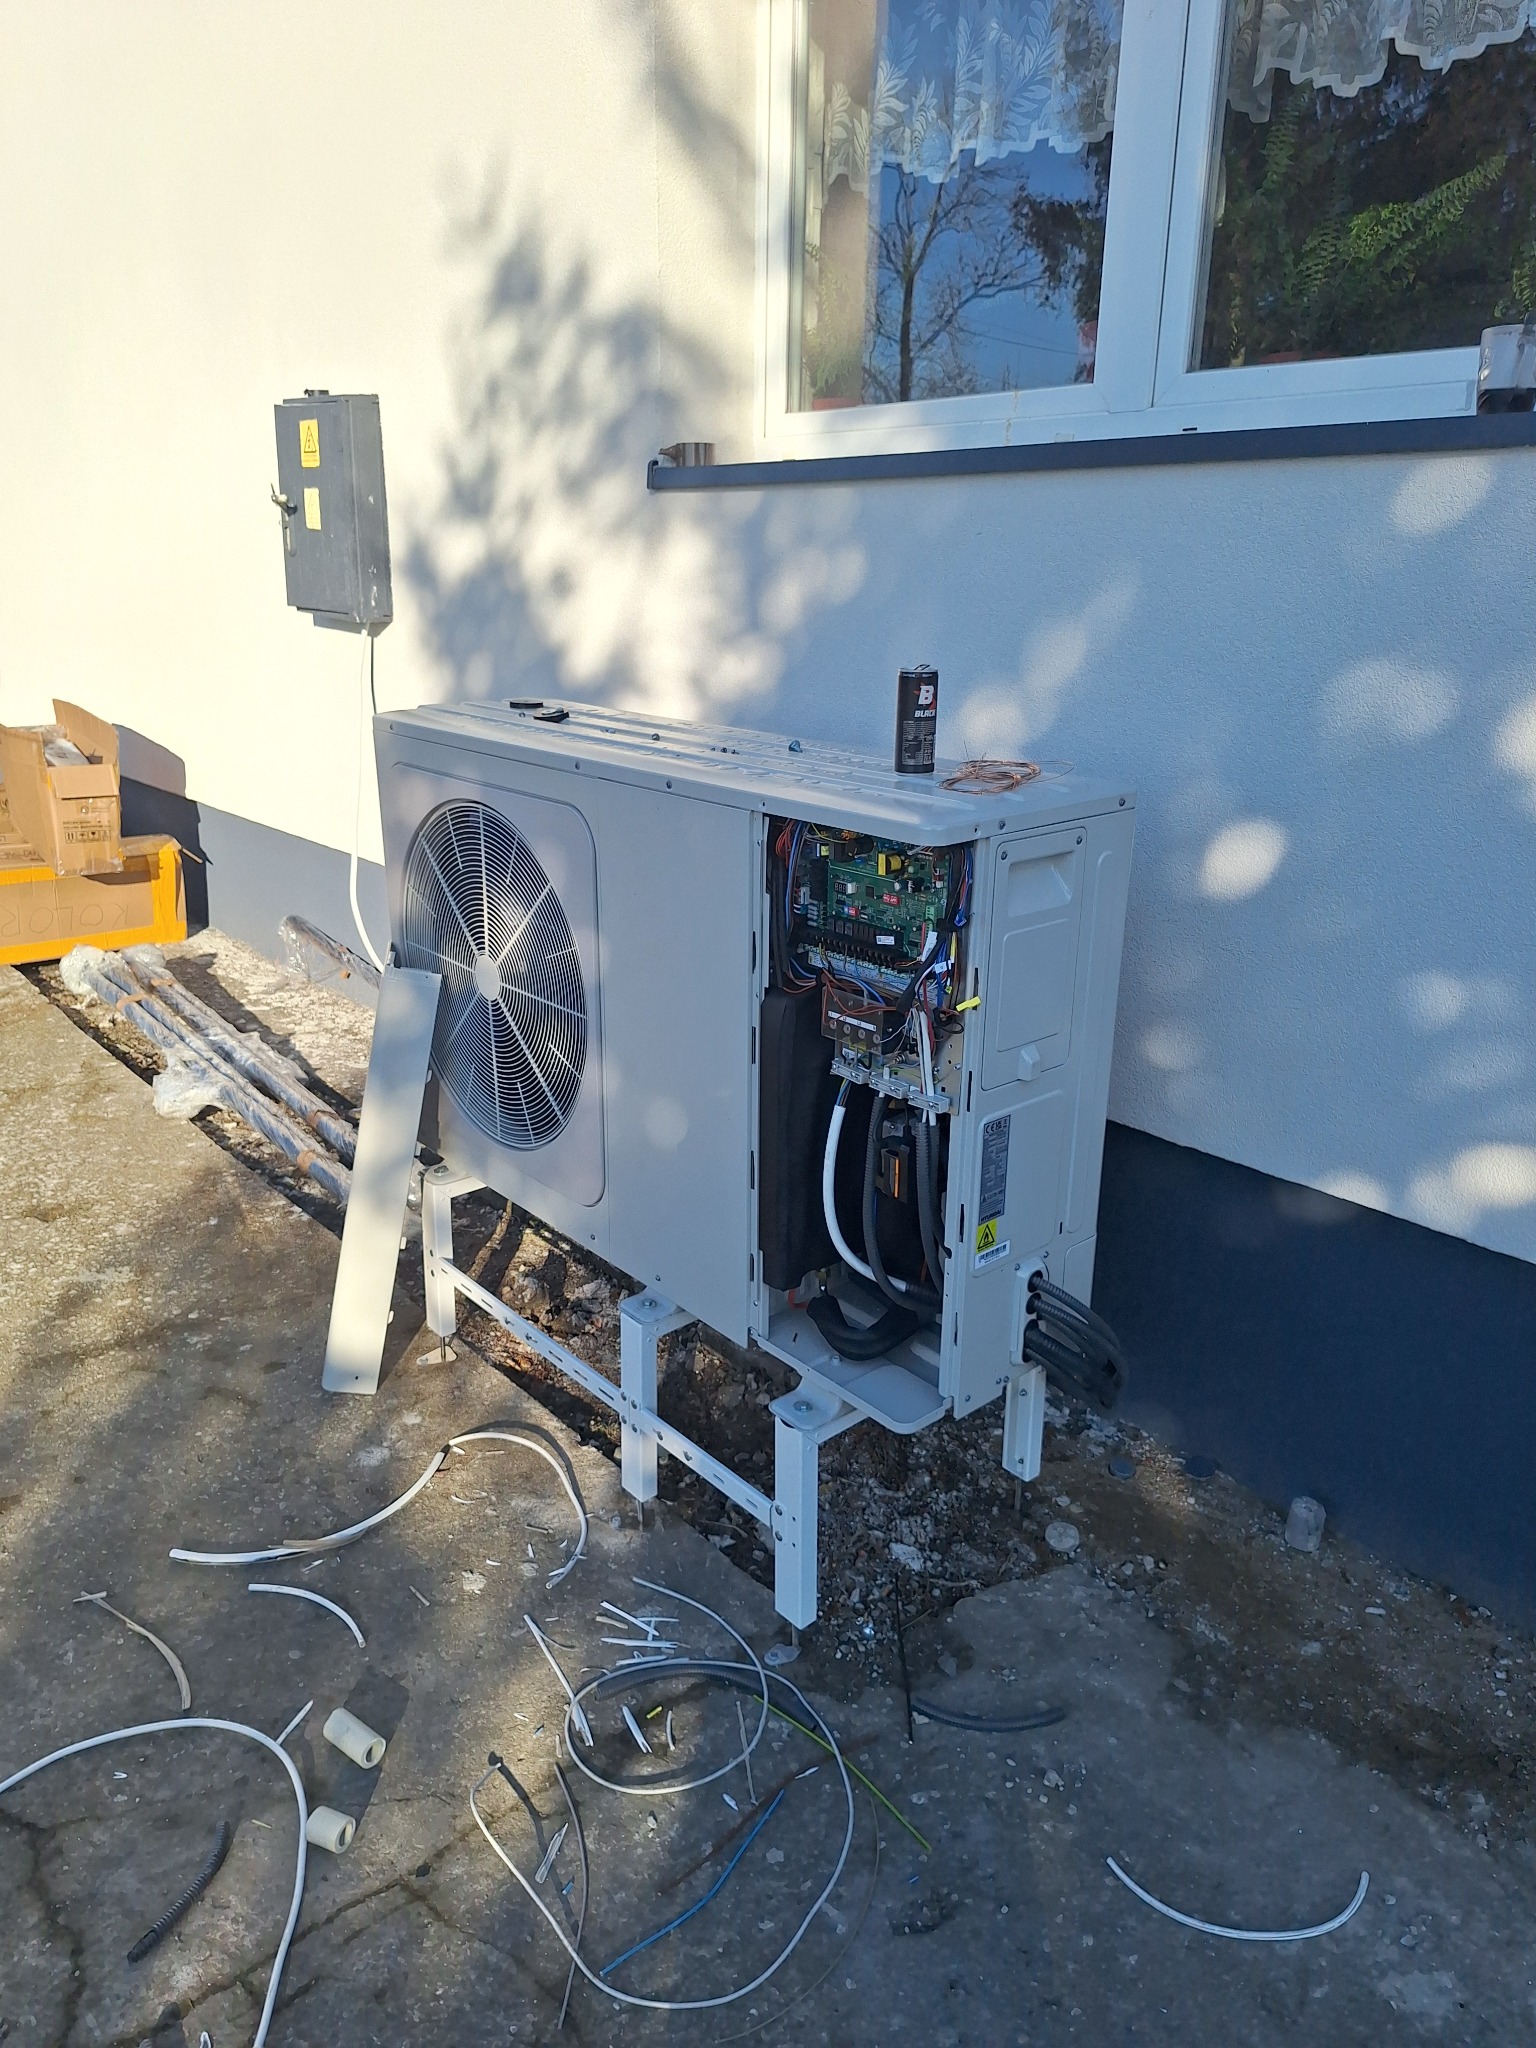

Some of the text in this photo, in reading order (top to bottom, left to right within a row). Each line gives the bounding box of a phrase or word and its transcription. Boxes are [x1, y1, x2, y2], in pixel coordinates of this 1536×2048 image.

[918, 685, 935, 705] B
[0, 903, 128, 937] KOLOR
[980, 1208, 1002, 1222] HYUNDAI
